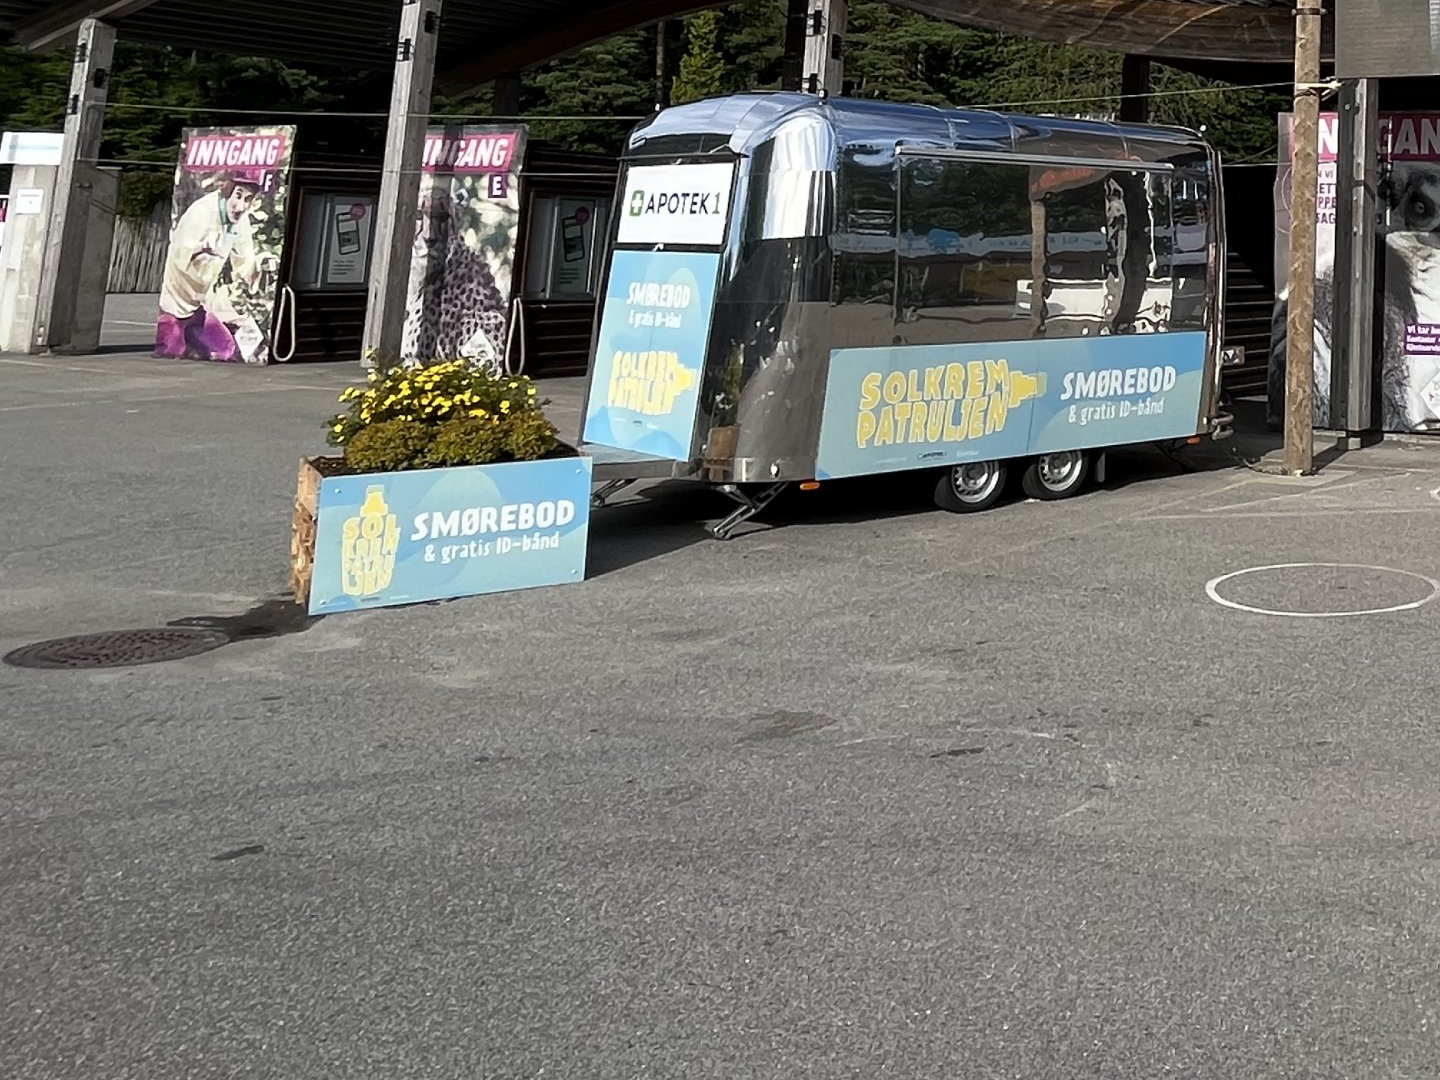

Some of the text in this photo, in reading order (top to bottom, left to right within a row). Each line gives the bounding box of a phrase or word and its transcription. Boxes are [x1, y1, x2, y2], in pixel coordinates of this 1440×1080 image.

[187, 138, 280, 166] INNGANG
[264, 173, 273, 192] F
[492, 175, 502, 196] E
[644, 191, 721, 215] APOTEK 1
[859, 359, 1011, 411] SOLKREM
[1060, 365, 1177, 400] SMØREBOD
[856, 392, 1009, 449] PATRULJEN
[1068, 404, 1078, 423] &
[1080, 401, 1115, 426] gratis
[410, 499, 575, 541] SMØREBOD
[423, 530, 560, 565] & gratis ID-bånd
